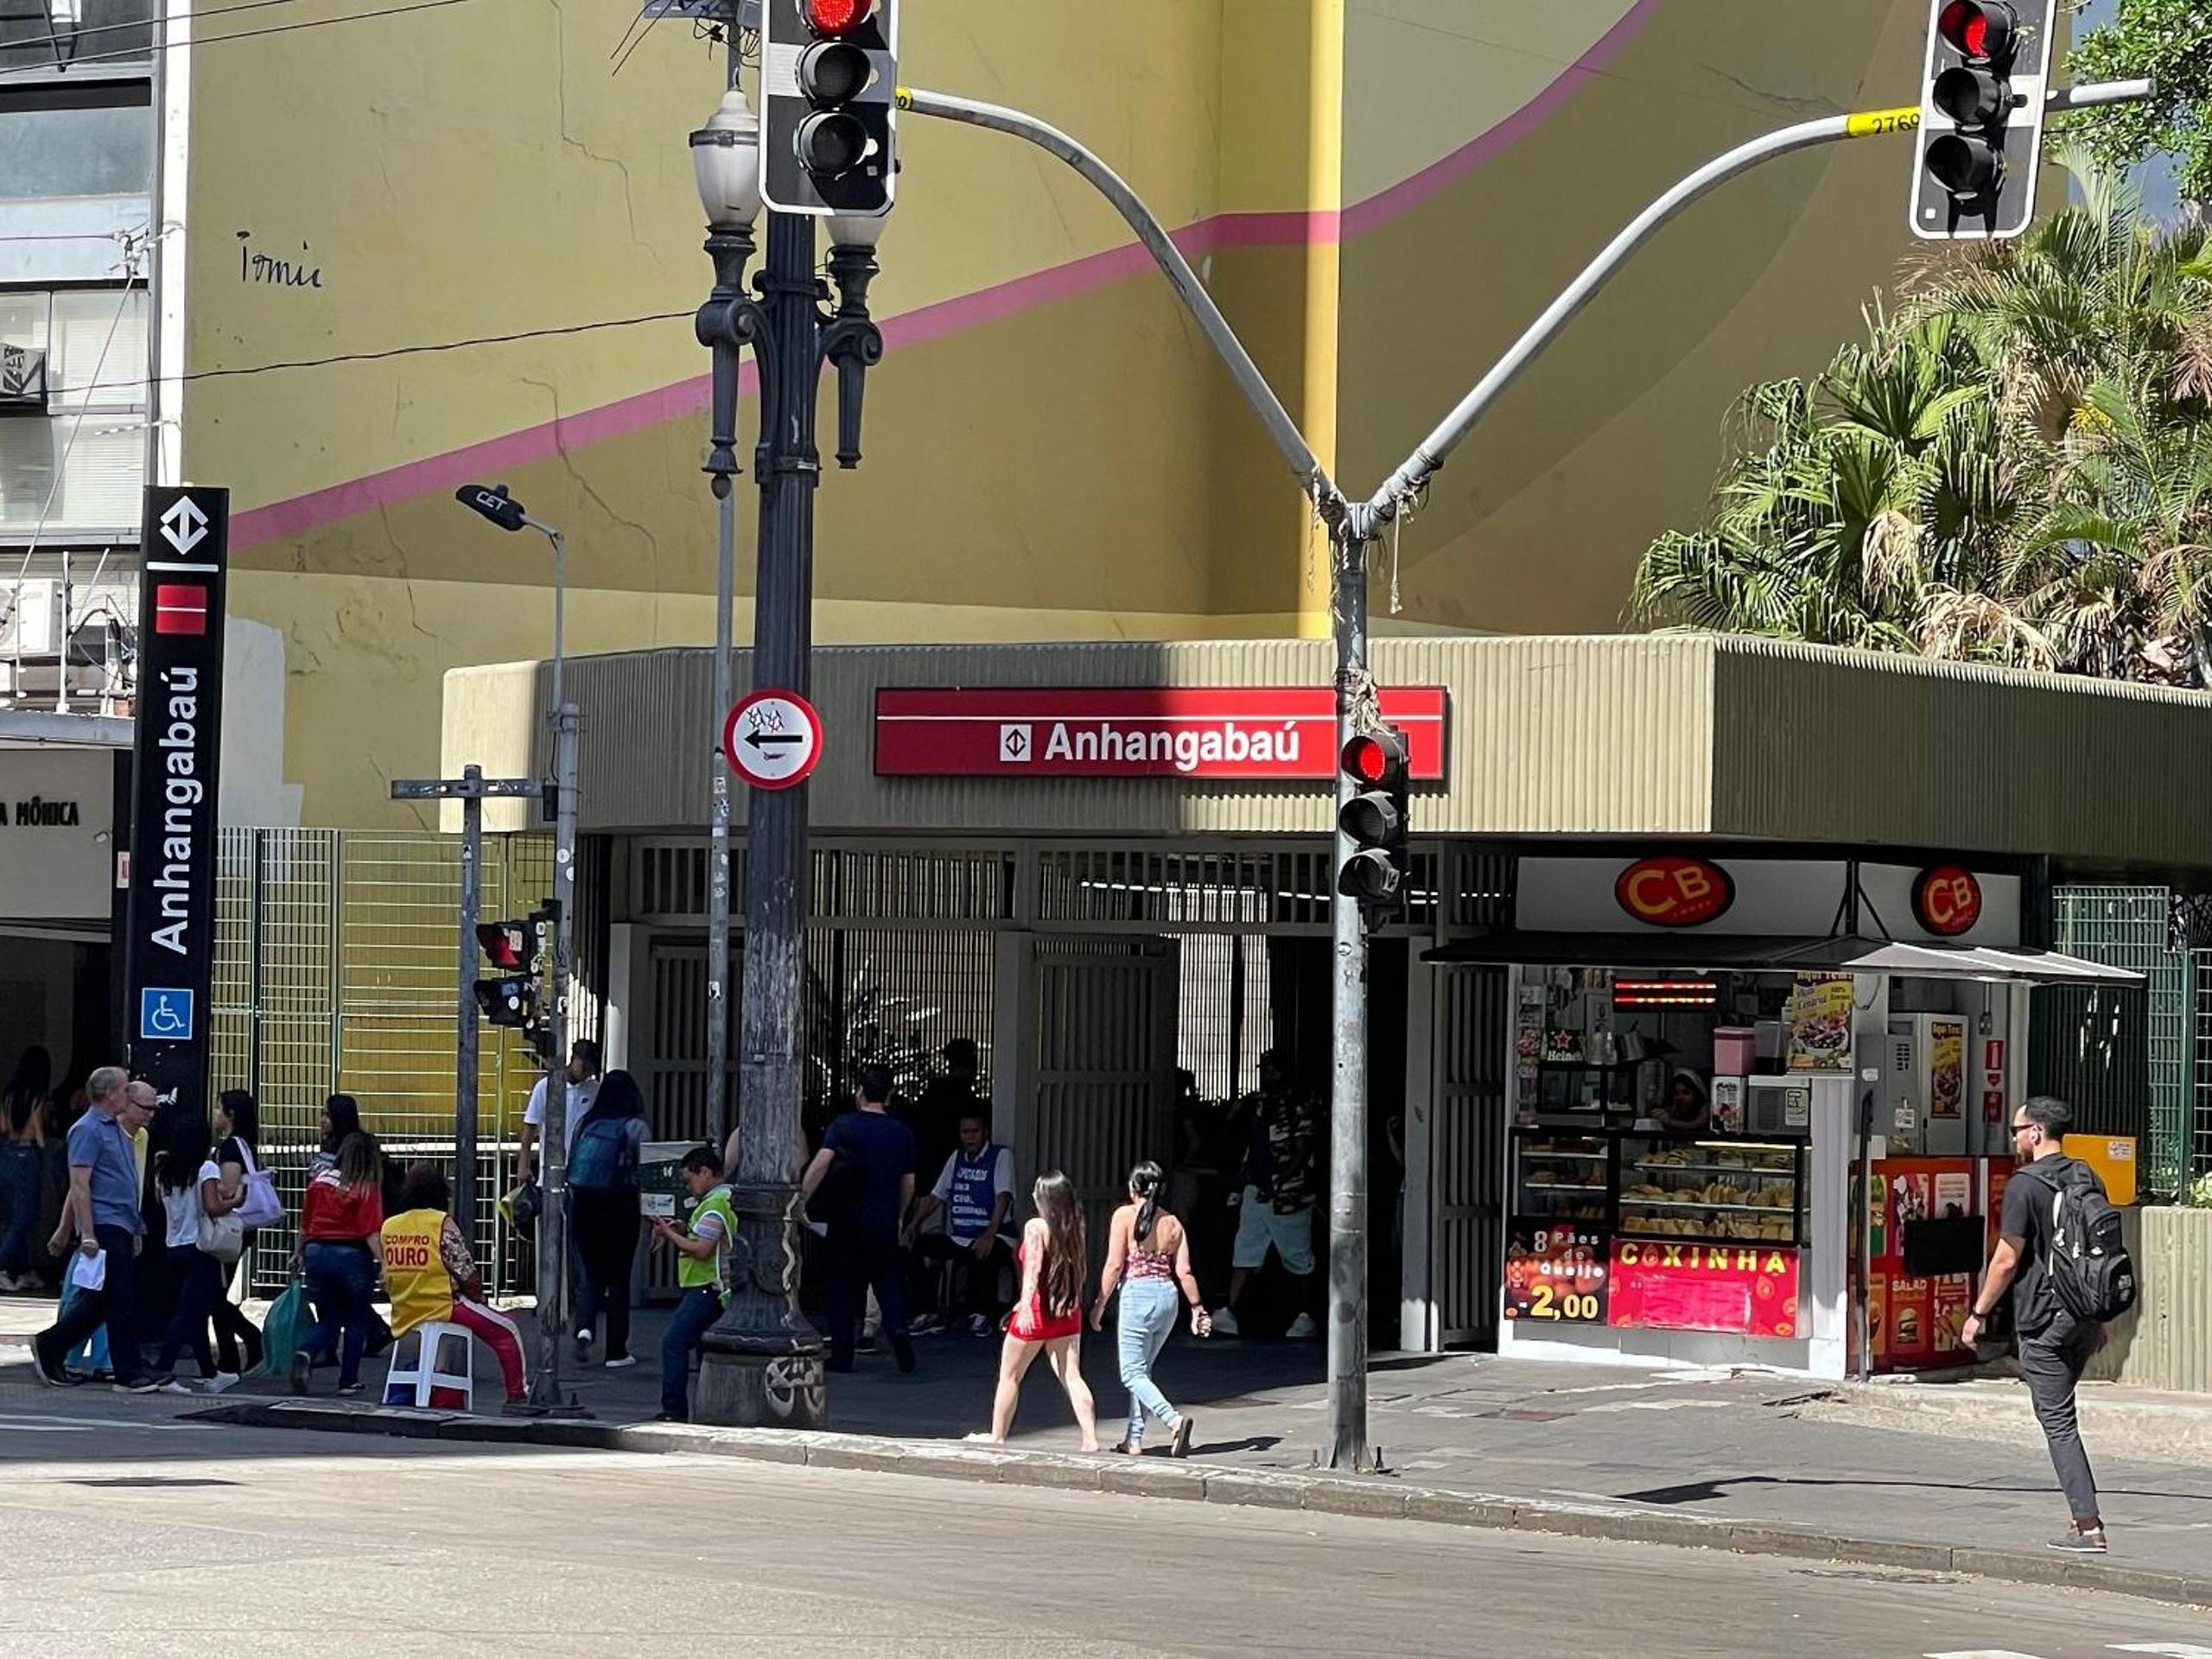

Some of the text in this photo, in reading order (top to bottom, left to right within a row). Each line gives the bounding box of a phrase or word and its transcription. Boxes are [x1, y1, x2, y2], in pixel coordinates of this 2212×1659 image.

[476, 491, 508, 511] CET
[1044, 721, 1300, 772] Anhangabaú
[16, 795, 79, 826] MÔNICA
[151, 667, 203, 955] Anhangabaú
[1628, 866, 1712, 915] CB
[1928, 876, 1972, 925] CB
[385, 1235, 429, 1245] COMPRO
[1534, 1230, 1599, 1253] 8 Pães
[386, 1247, 429, 1266] OURO
[1564, 1248, 1585, 1260] de
[1540, 1262, 1604, 1280] Queijo
[1529, 1284, 1599, 1321] 2,00
